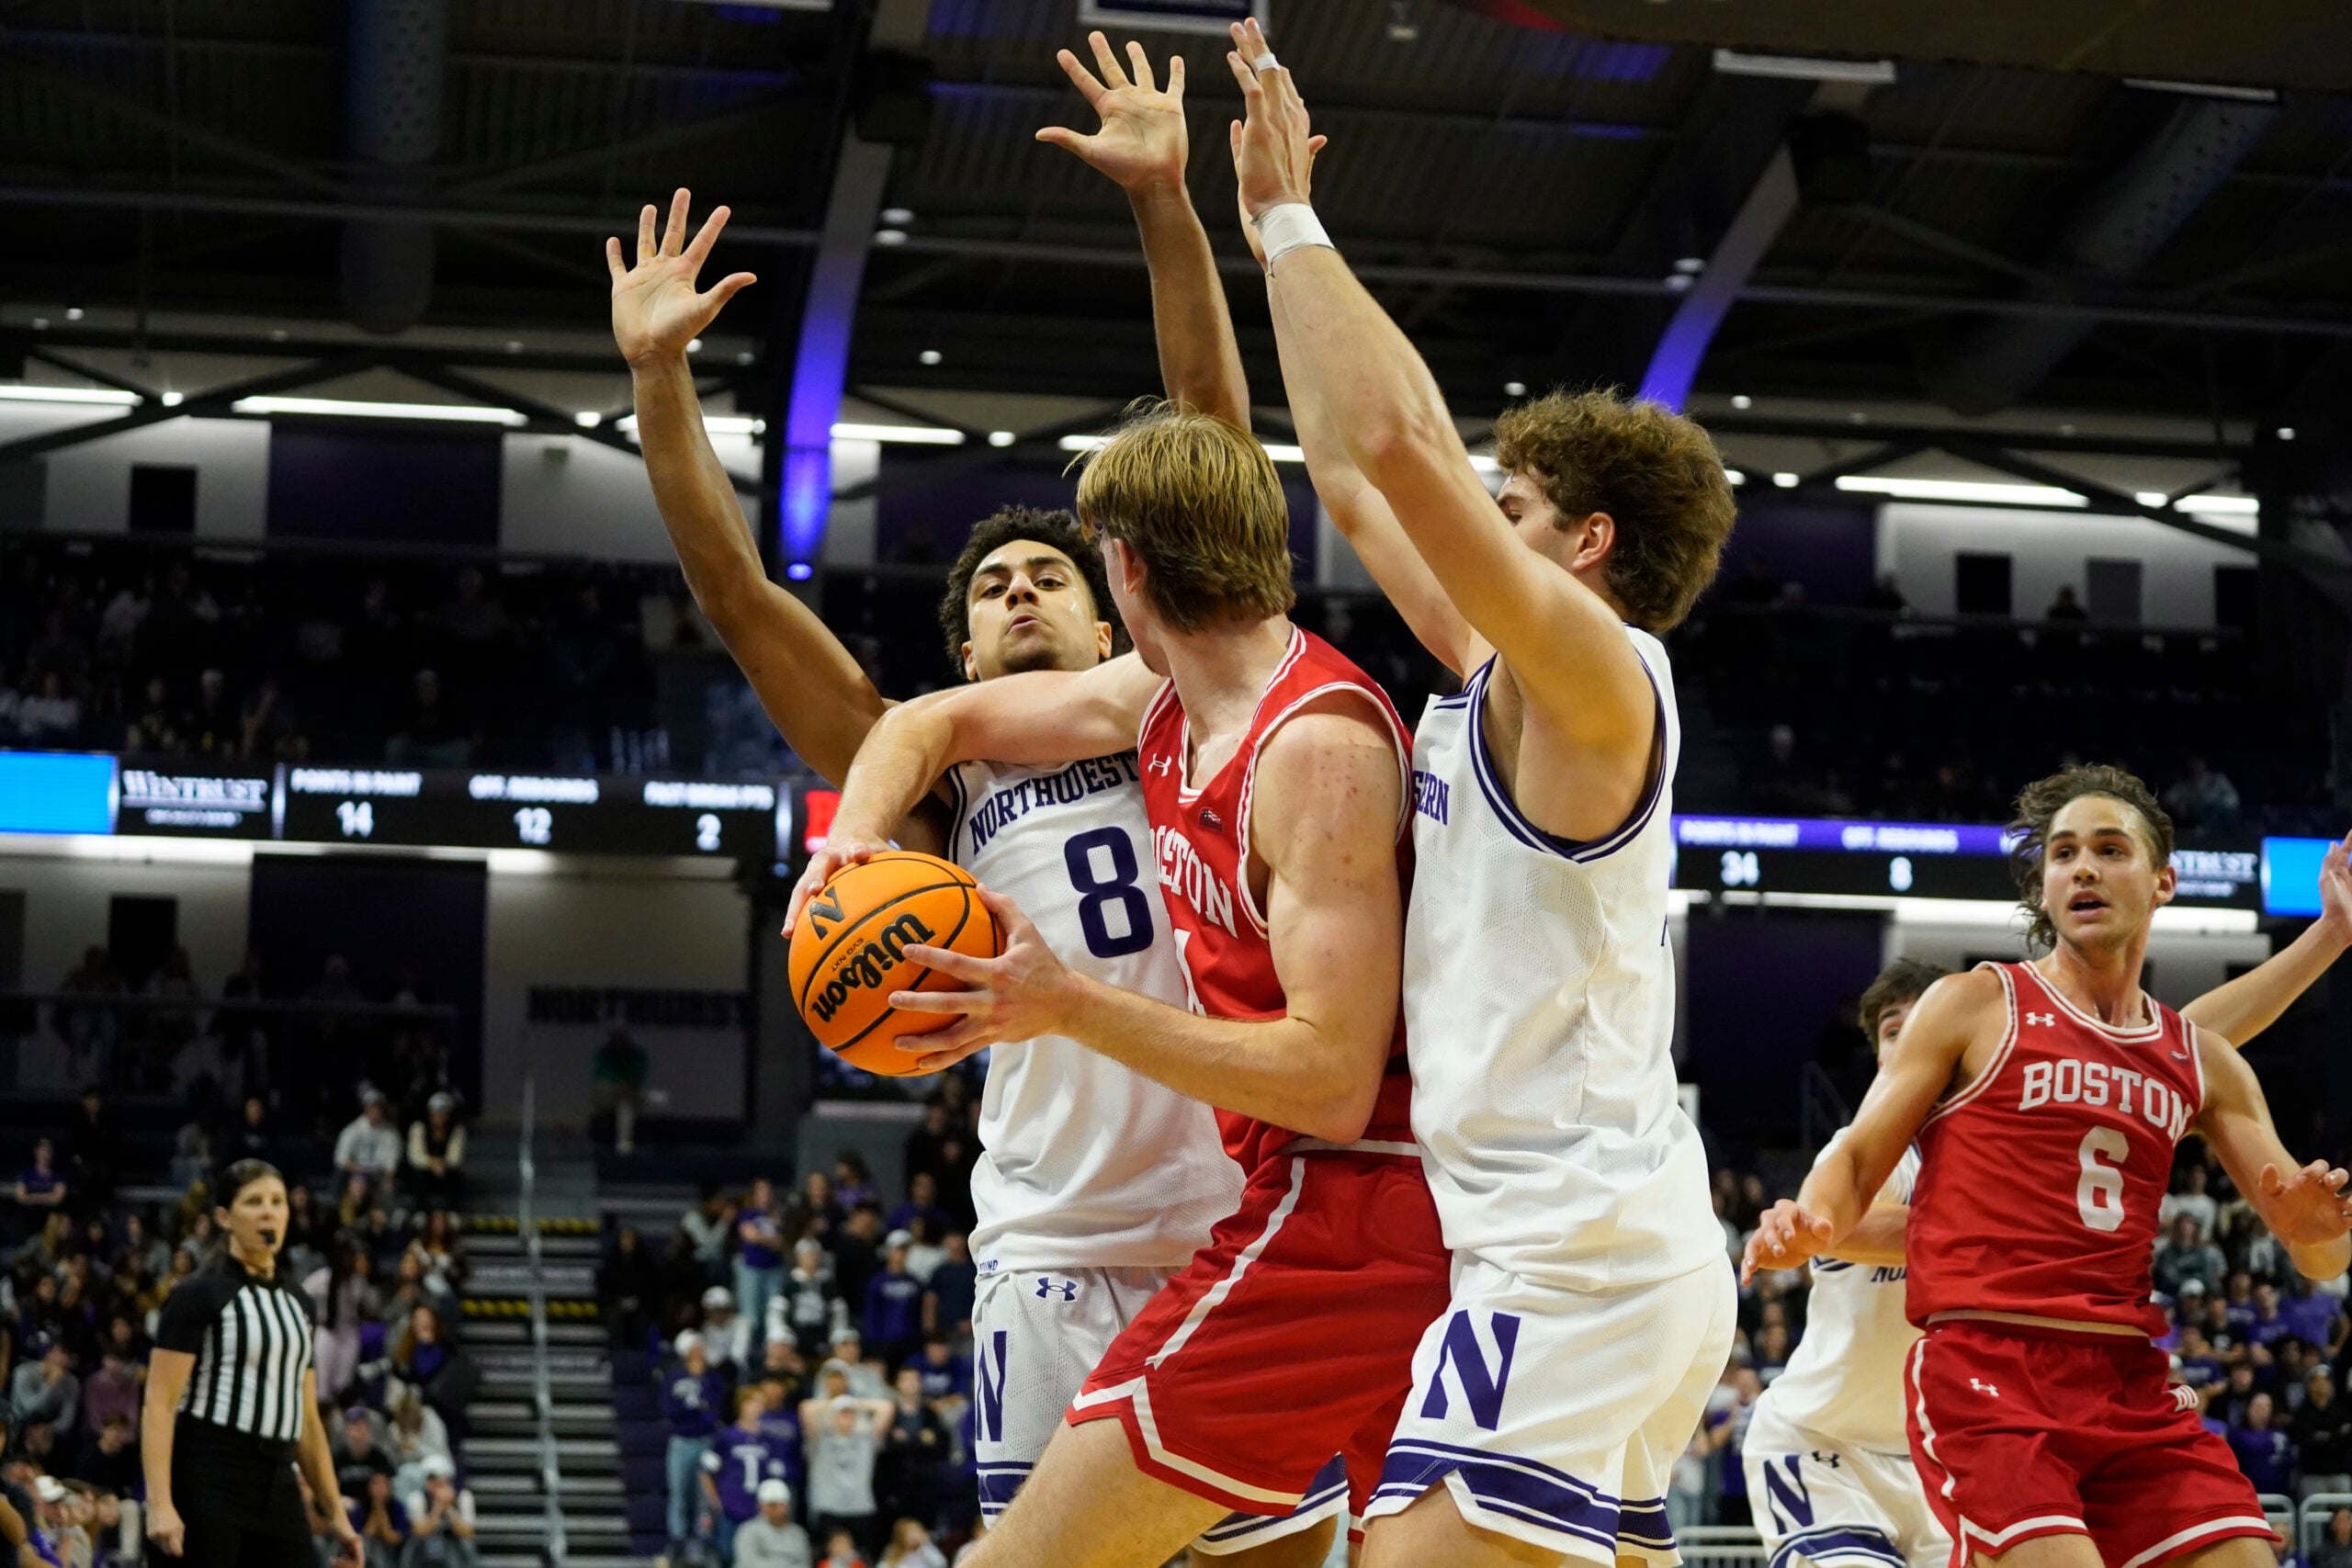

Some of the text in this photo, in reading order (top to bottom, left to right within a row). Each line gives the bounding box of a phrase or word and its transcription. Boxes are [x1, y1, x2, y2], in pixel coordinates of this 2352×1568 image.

[336, 800, 374, 838] 14
[514, 807, 553, 845] 12
[695, 813, 722, 852] 2
[1064, 826, 1155, 958] 8
[1149, 825, 1238, 940] OSTON
[1720, 850, 1760, 886] 34
[2169, 850, 2257, 879] NTRUST
[808, 886, 846, 941] N
[810, 913, 936, 1023] Wilson
[2018, 1058, 2194, 1148] BOSTON
[2076, 1124, 2131, 1233] 6
[1419, 1308, 1521, 1432] N
[1762, 1453, 1815, 1537] N
